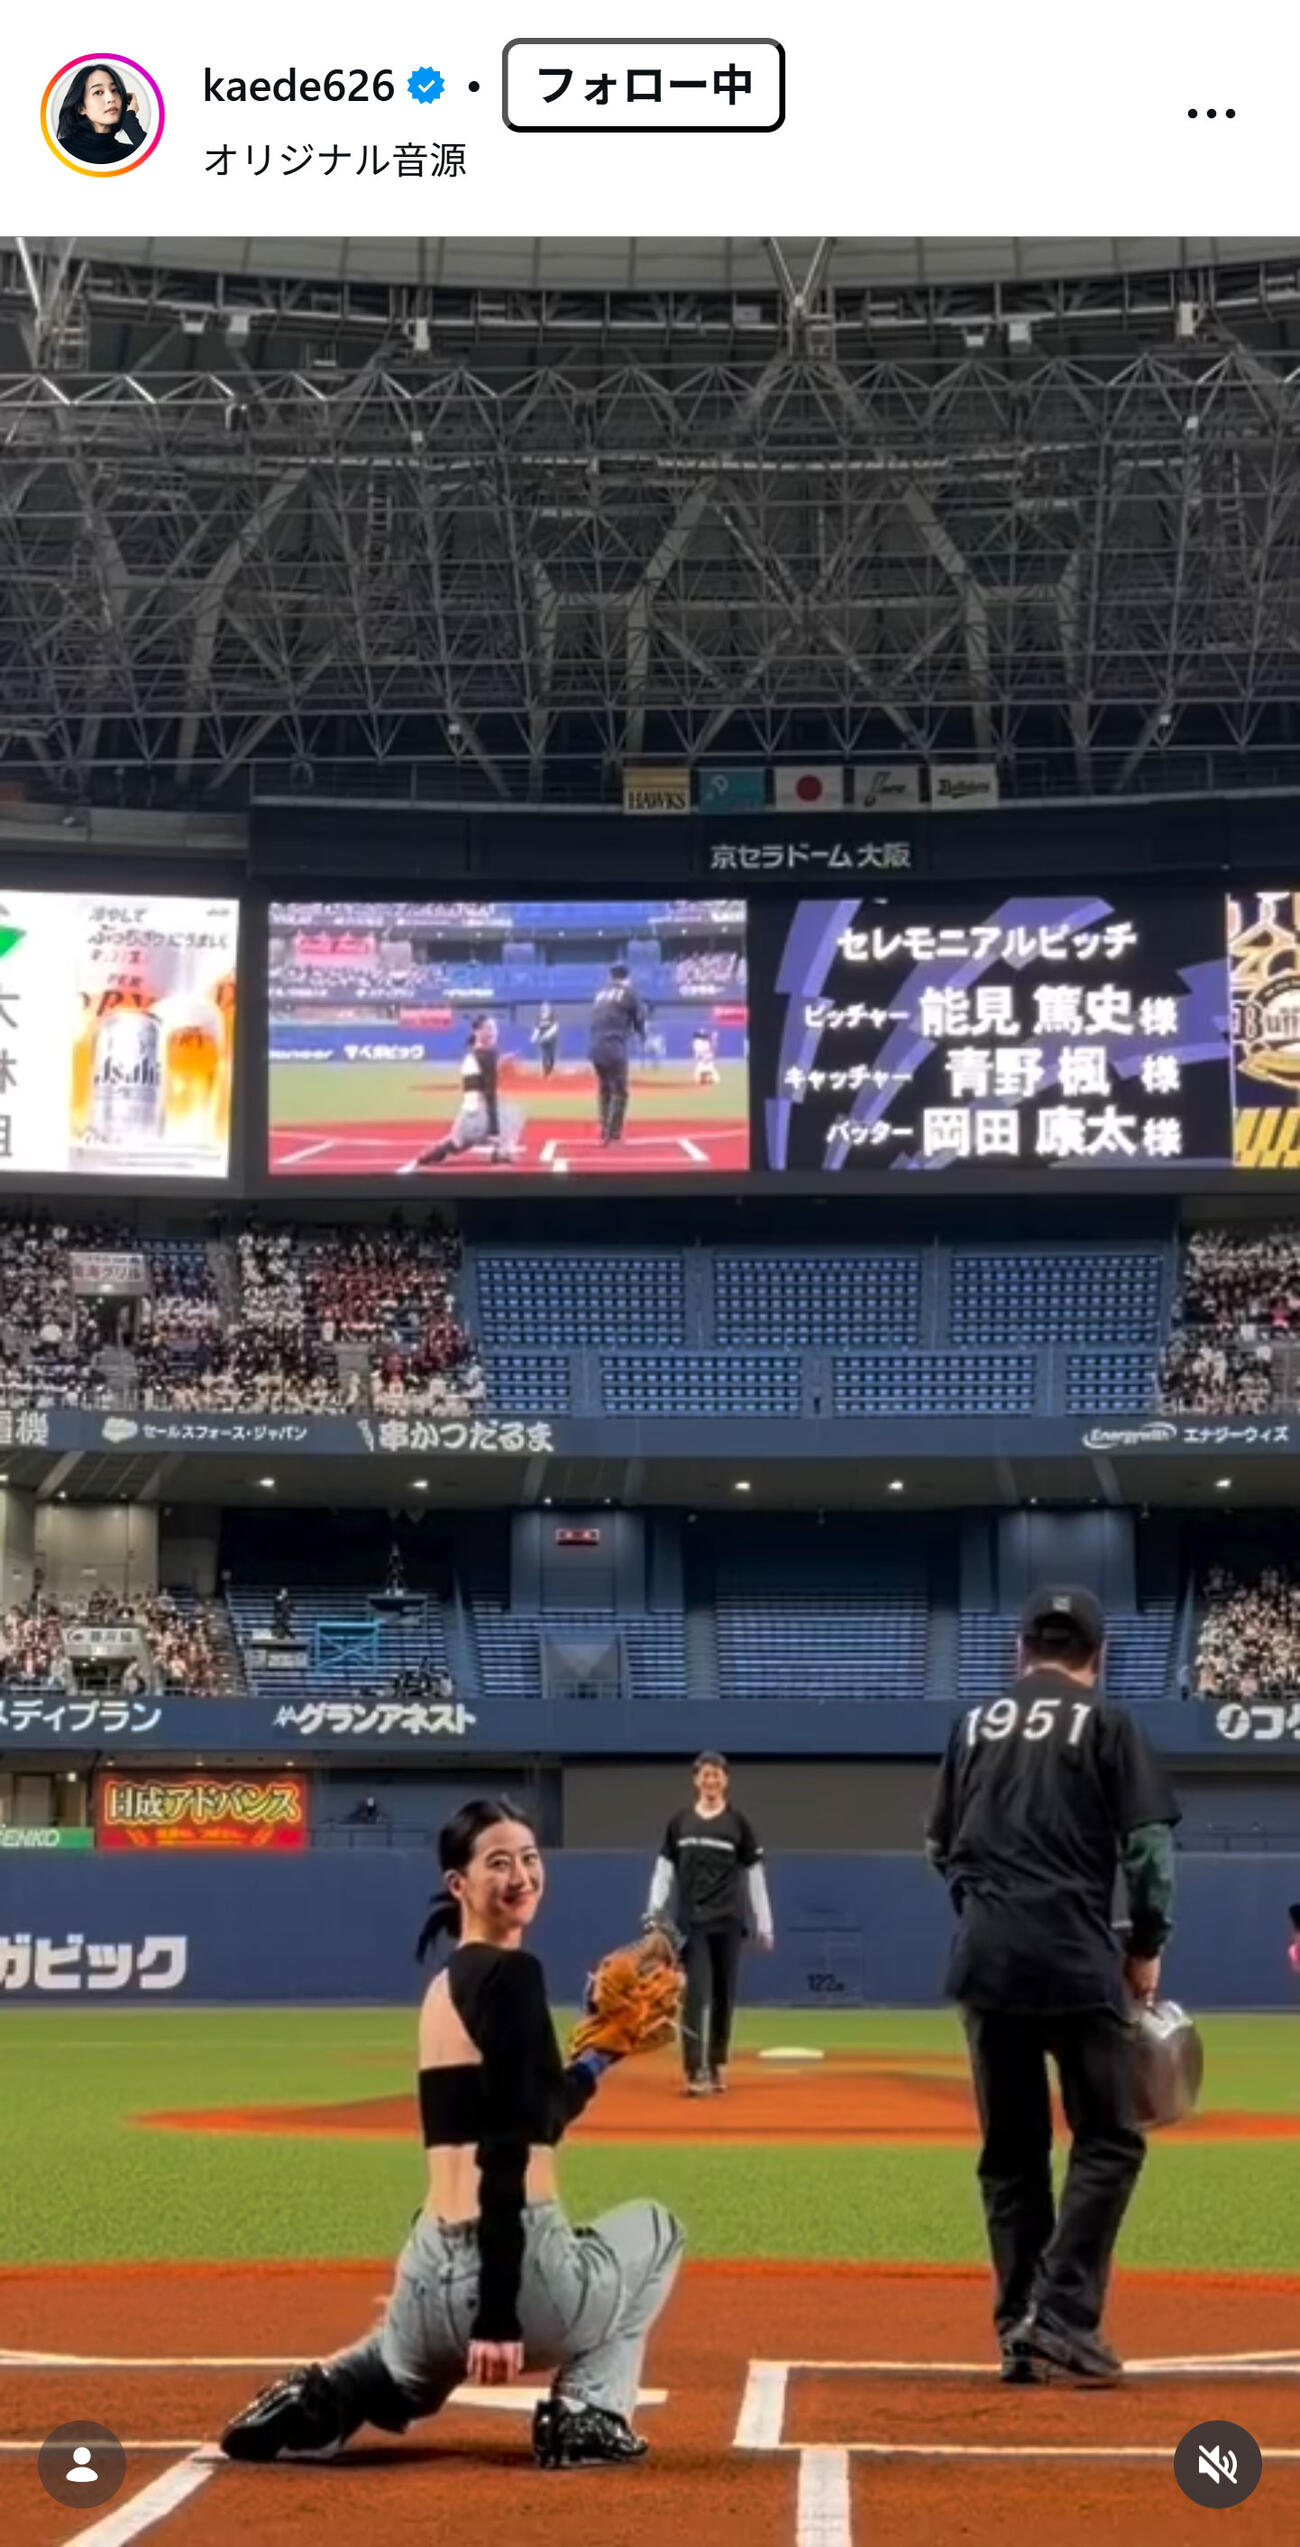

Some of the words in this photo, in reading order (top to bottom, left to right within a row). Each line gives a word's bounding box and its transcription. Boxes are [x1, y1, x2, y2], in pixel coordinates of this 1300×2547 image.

[628, 791, 686, 809] HAWKS
[837, 923, 1137, 961] セレモニアルピッチ
[804, 1003, 910, 1029] ピッチャー
[919, 985, 1021, 1037] 能見
[1139, 996, 1178, 1036] 様
[784, 1064, 912, 1090] キャッチャー
[945, 1046, 1046, 1098] 青野
[1057, 1046, 1111, 1096] 楓
[1141, 1054, 1180, 1094] 様
[826, 1120, 913, 1145] バッター
[923, 1107, 1019, 1157] 岡田
[1142, 1117, 1181, 1157] 様
[378, 1418, 554, 1452] 串かつだるま
[1183, 1425, 1290, 1444] エナジーウィズ
[299, 1701, 477, 1735] グランアネスト
[967, 1697, 1092, 1747] 1951
[1250, 1703, 1300, 1740] コ
[0, 1827, 60, 1847] ENKO
